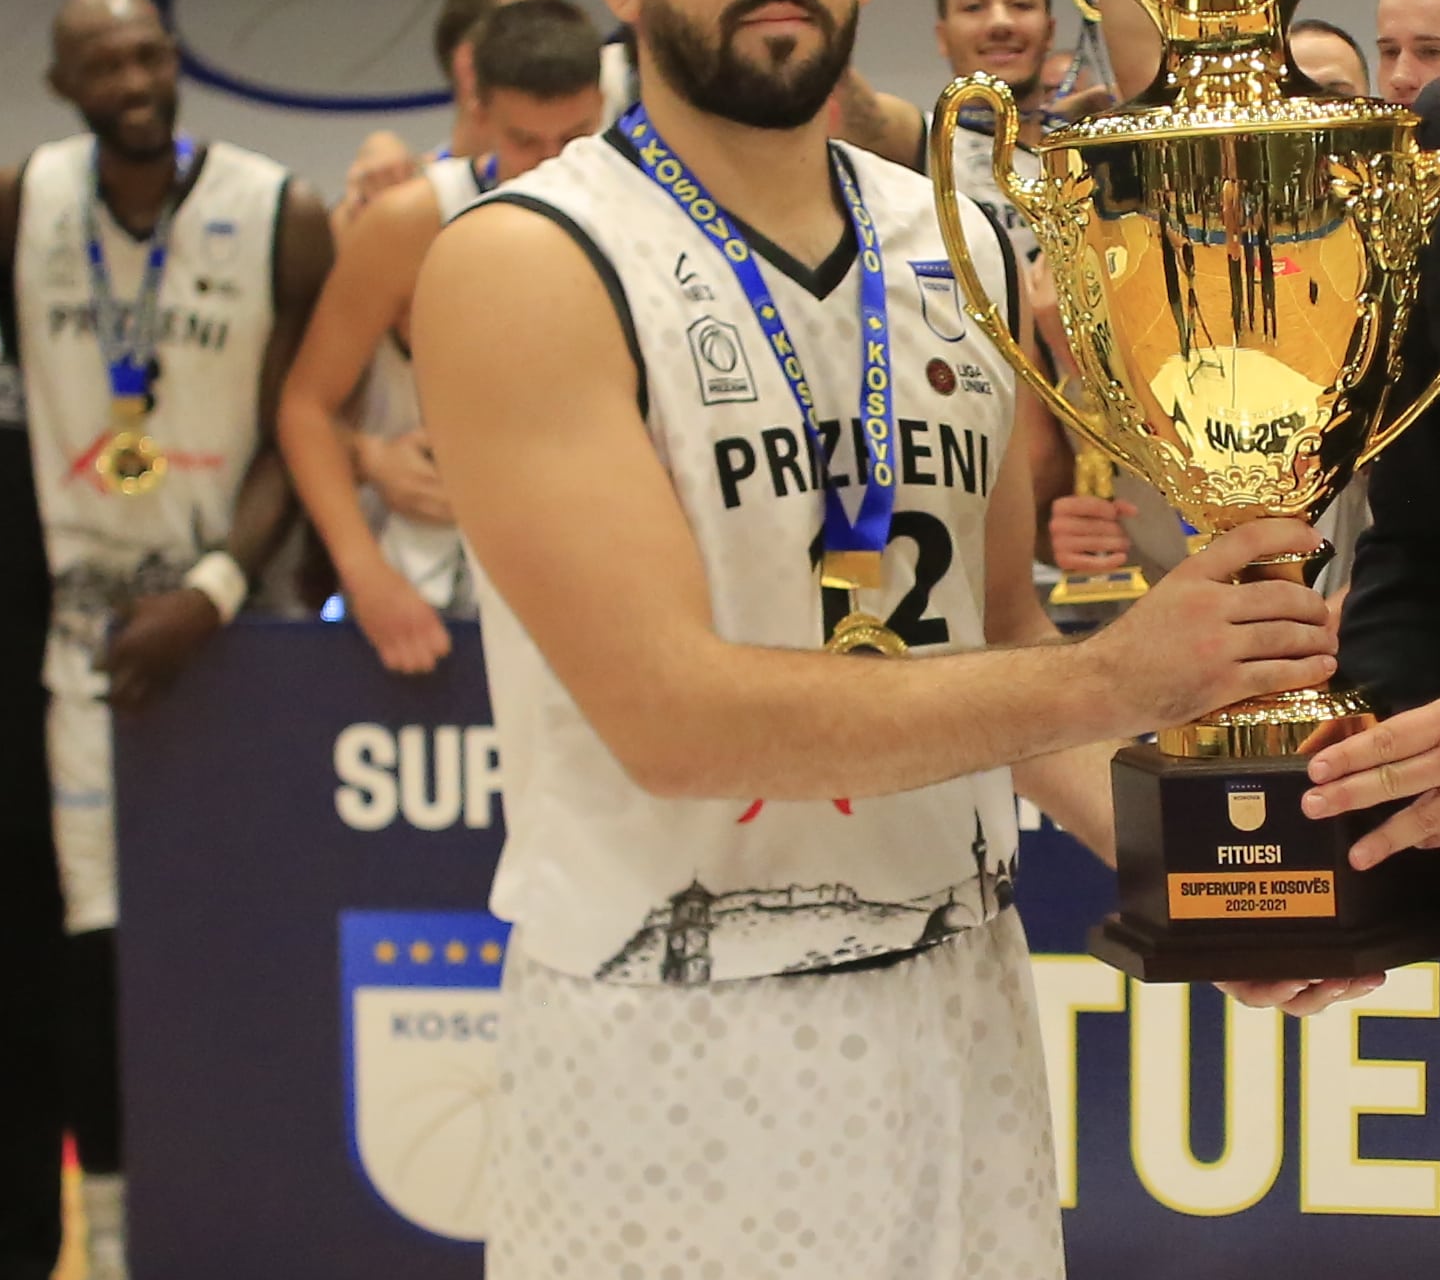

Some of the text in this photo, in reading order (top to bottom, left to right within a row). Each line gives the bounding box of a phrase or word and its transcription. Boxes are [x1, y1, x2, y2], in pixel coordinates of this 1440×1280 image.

[639, 137, 749, 263] KOSOVO
[865, 340, 894, 488] KOSOVO
[1217, 844, 1282, 865] FITUESI
[1180, 876, 1330, 897] SUPERKUPA E KOSOVËS
[1225, 898, 1287, 912] 2020-2021
